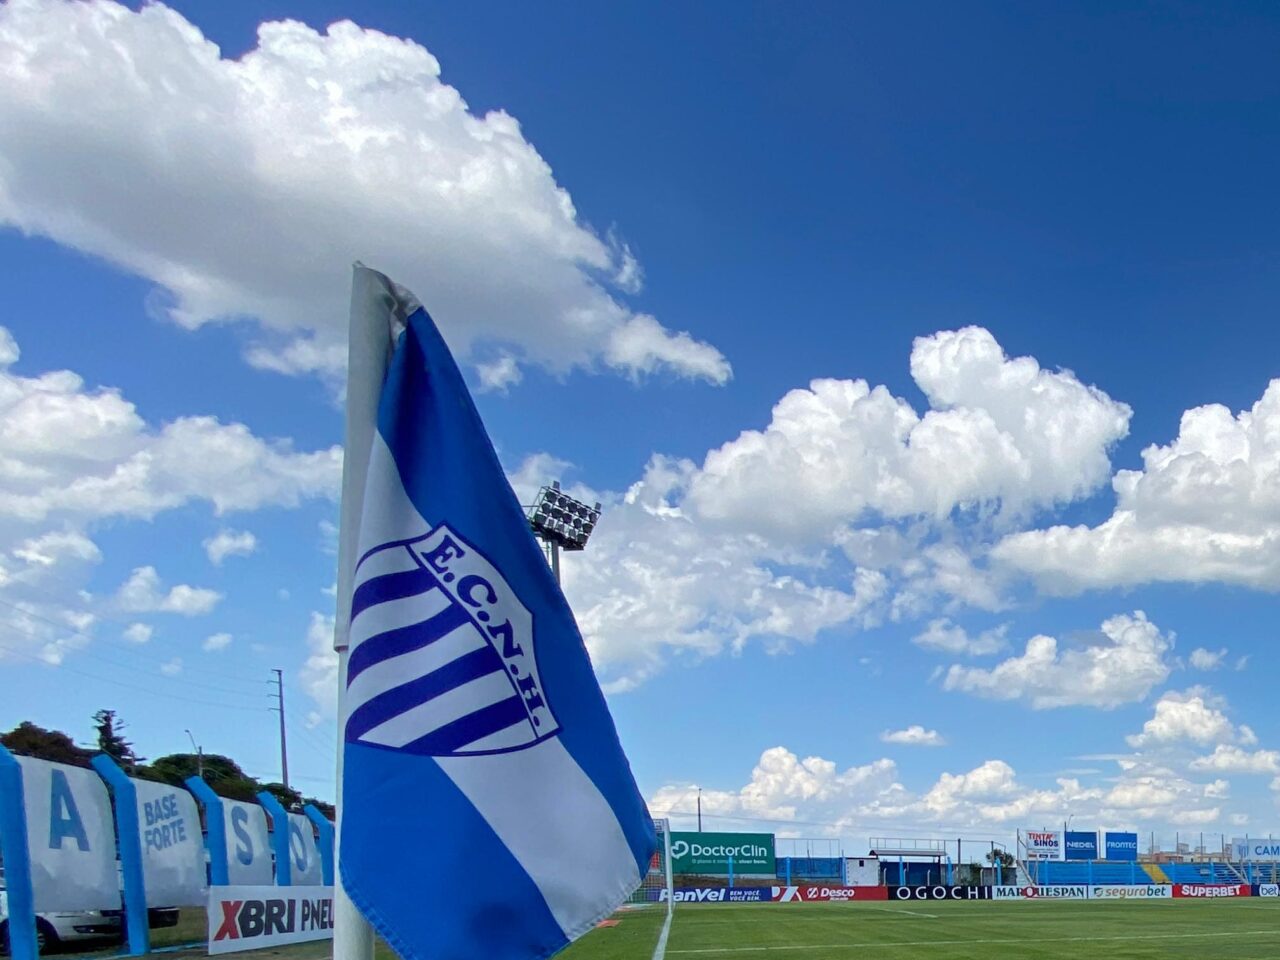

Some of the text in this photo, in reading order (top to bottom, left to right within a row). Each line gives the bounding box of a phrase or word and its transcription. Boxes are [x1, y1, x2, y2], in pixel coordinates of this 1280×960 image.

[49, 768, 91, 851] A
[144, 793, 179, 826] BASE
[144, 818, 187, 854] FORTE
[231, 805, 254, 865] S
[691, 844, 767, 856] DoctorClin
[1067, 841, 1095, 849] NEDEL
[1107, 841, 1136, 849] FRONTEC
[820, 889, 855, 897] Desco
[896, 886, 988, 900] OGOCHI
[996, 886, 1084, 898] MARQUESPAN
[1105, 886, 1166, 899] segurobet
[1181, 885, 1241, 897] SUPERBET
[214, 899, 334, 941] XBRI PNEU
